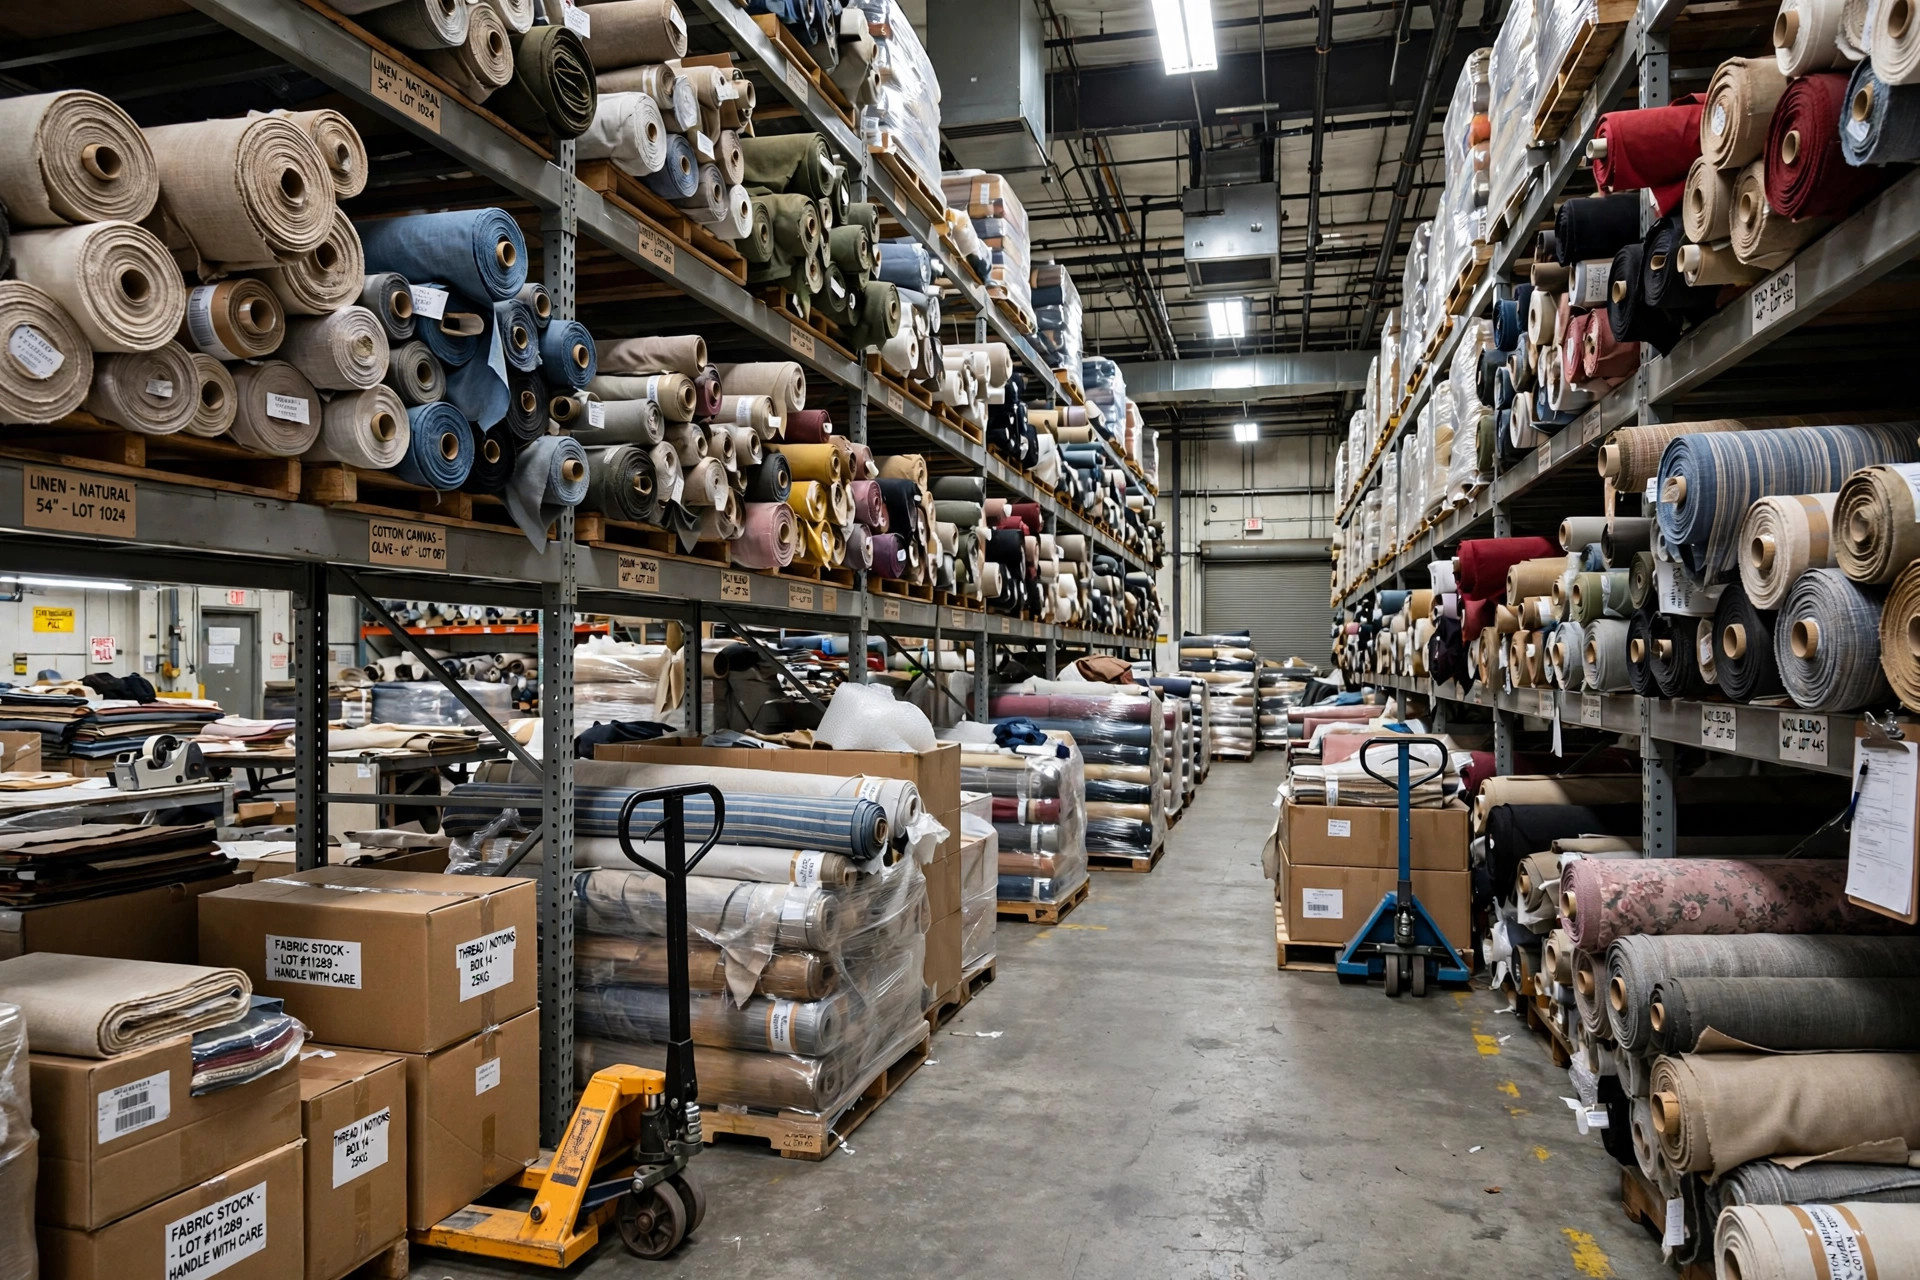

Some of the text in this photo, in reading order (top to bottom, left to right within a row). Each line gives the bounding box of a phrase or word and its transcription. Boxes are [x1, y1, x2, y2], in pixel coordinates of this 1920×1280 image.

[374, 57, 397, 80] LINEN
[406, 76, 440, 109] NATURAL
[400, 90, 414, 108] LOT
[418, 102, 434, 121] 1024
[30, 474, 66, 494] LINEN
[79, 481, 130, 502] NATURAL
[36, 497, 58, 514] 54"
[72, 502, 95, 518] LOT
[99, 506, 125, 522] 1024
[372, 524, 404, 540] COTTON
[406, 529, 436, 543] CANVAS
[371, 541, 393, 555] OLIVE
[419, 547, 431, 559] LOT
[275, 939, 309, 952] FABRIC
[311, 943, 344, 956] STOCK
[458, 941, 485, 960] THREAD
[489, 931, 515, 950] NOTIONS
[281, 954, 299, 965] LOT
[300, 956, 332, 969] #11289
[274, 967, 356, 985] HANDLE WITH CARE
[472, 970, 490, 987] 25KG
[333, 1126, 358, 1147] THREAD
[364, 1111, 390, 1132] NOTIONS
[171, 1211, 214, 1242] FABRIC
[217, 1192, 254, 1220] STOCK
[179, 1236, 201, 1258] LOT
[204, 1216, 243, 1246] #11289
[169, 1223, 264, 1280] HANDLE WITH CARE
